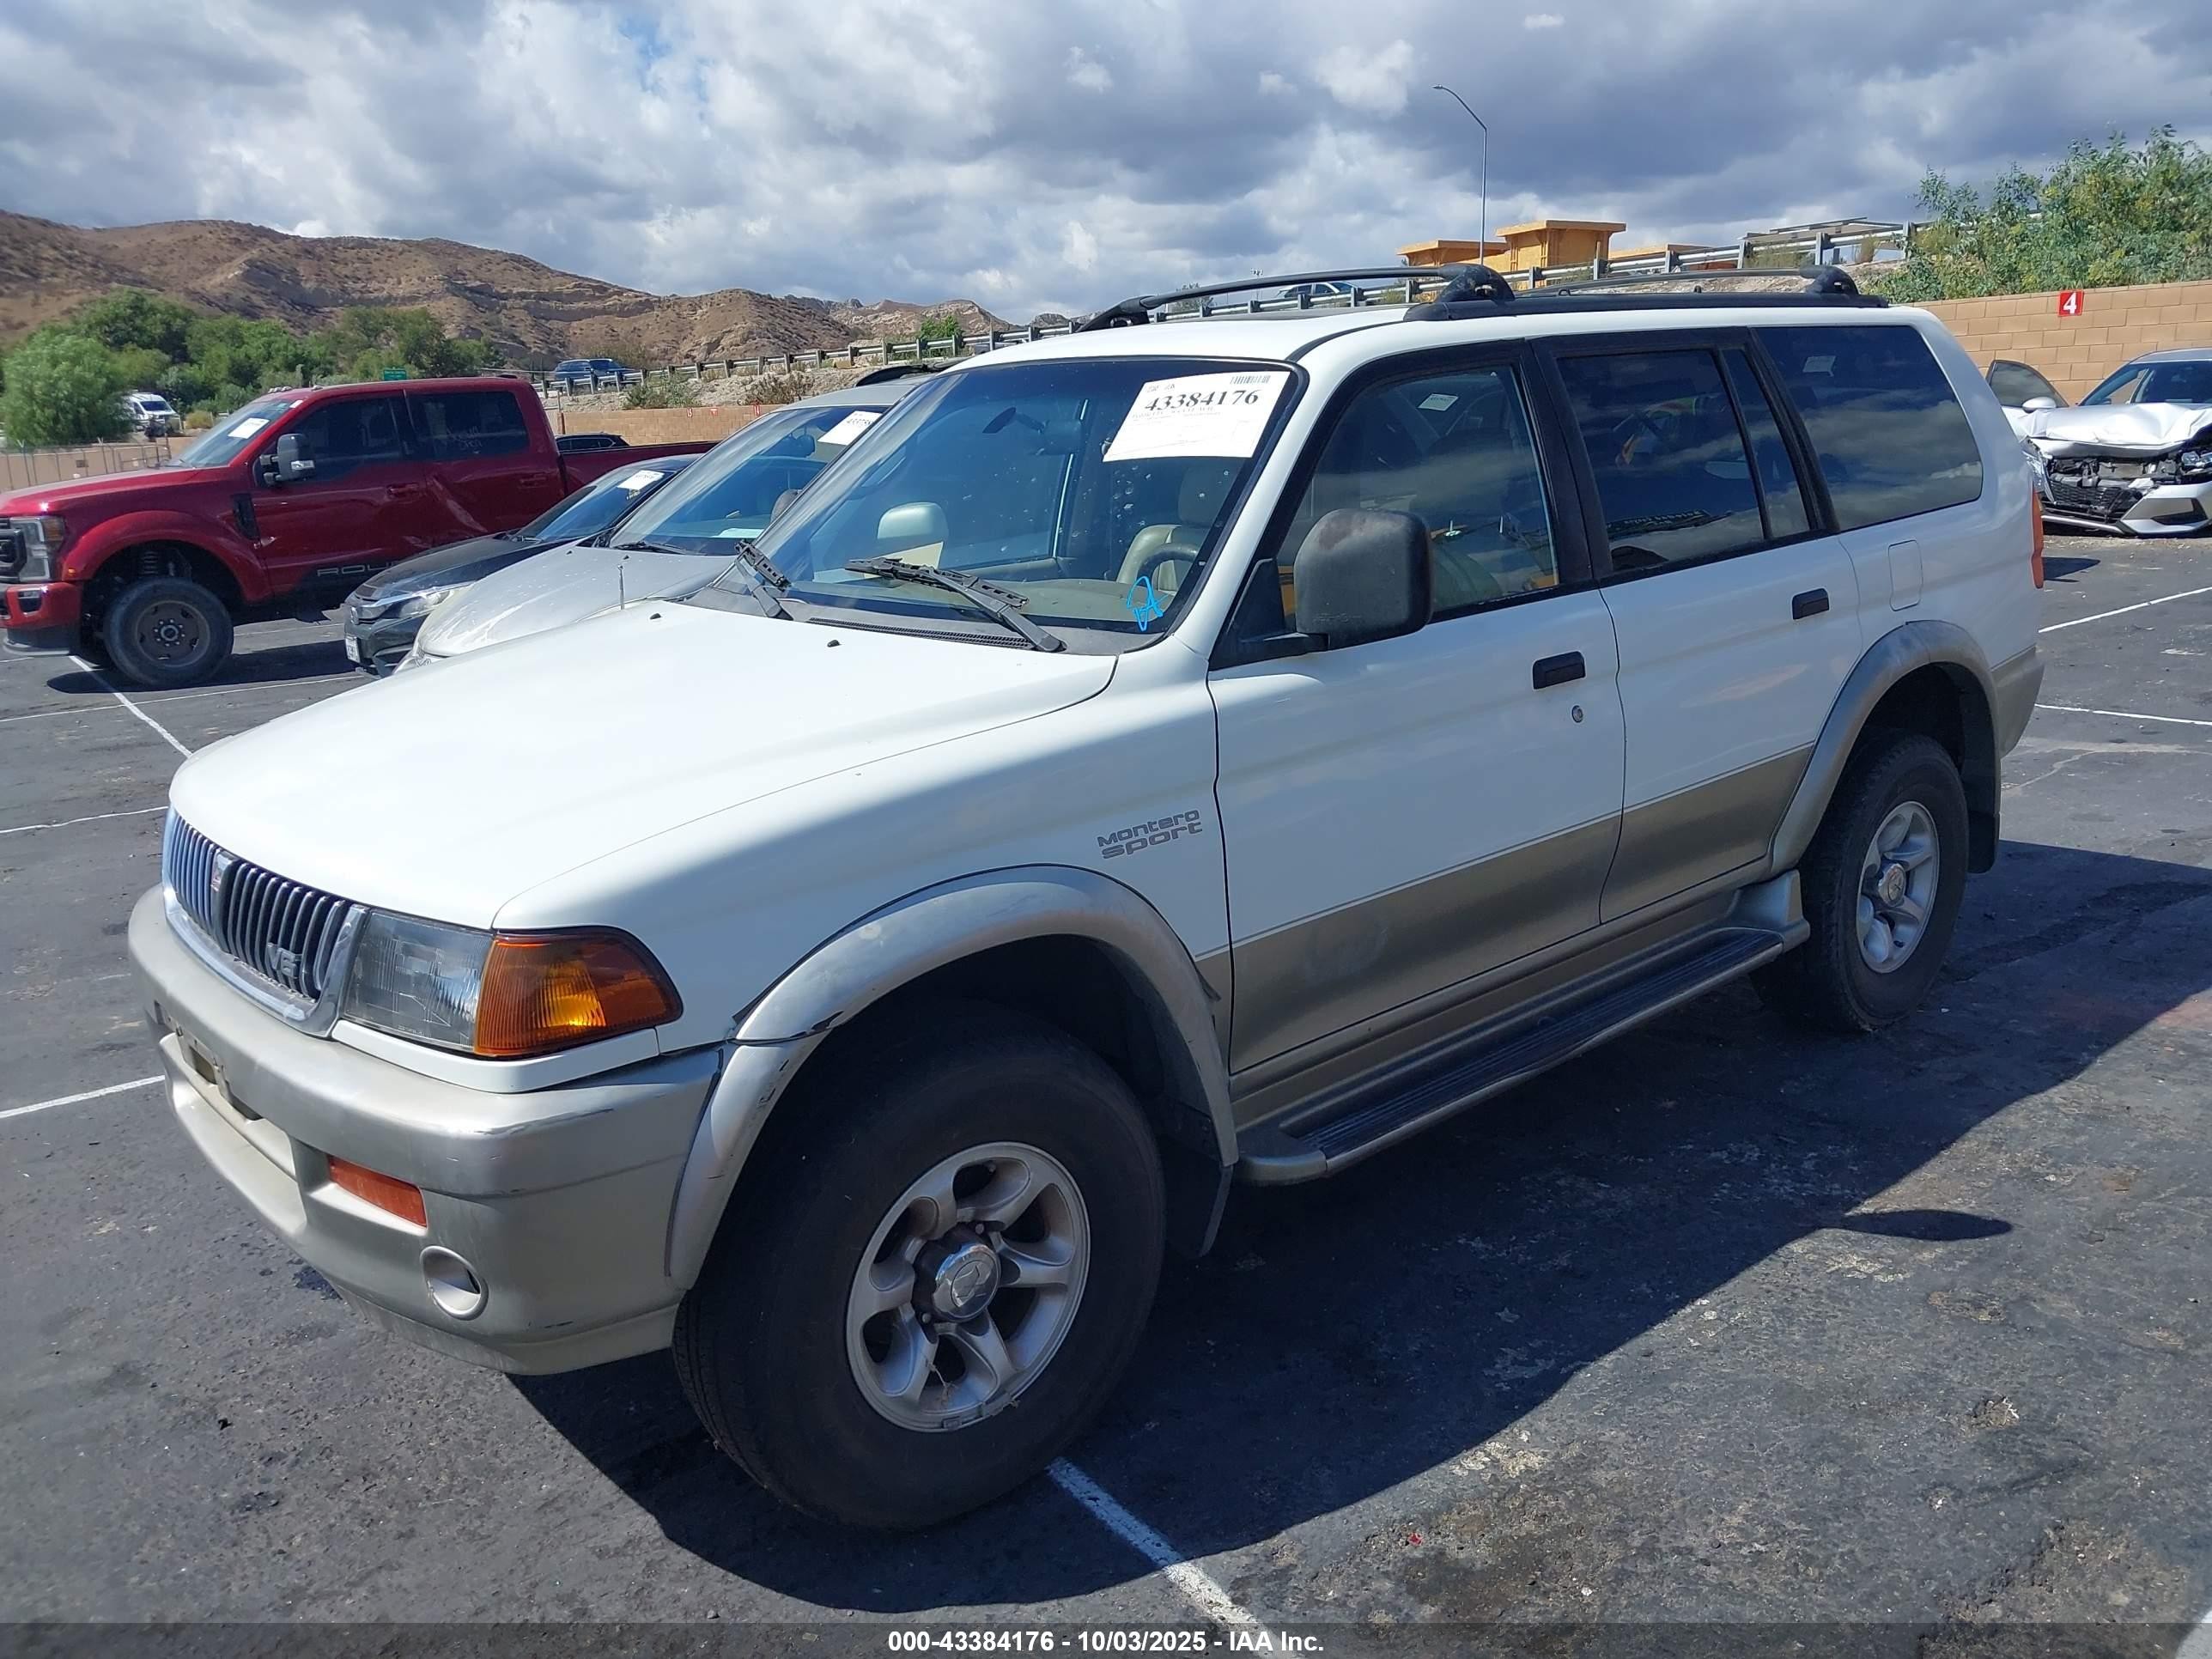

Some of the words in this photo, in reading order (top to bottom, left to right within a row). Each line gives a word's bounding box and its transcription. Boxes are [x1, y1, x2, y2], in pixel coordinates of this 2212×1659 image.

[2063, 292, 2076, 314] 4
[1145, 389, 1262, 411] 43384176
[267, 942, 297, 979] V6
